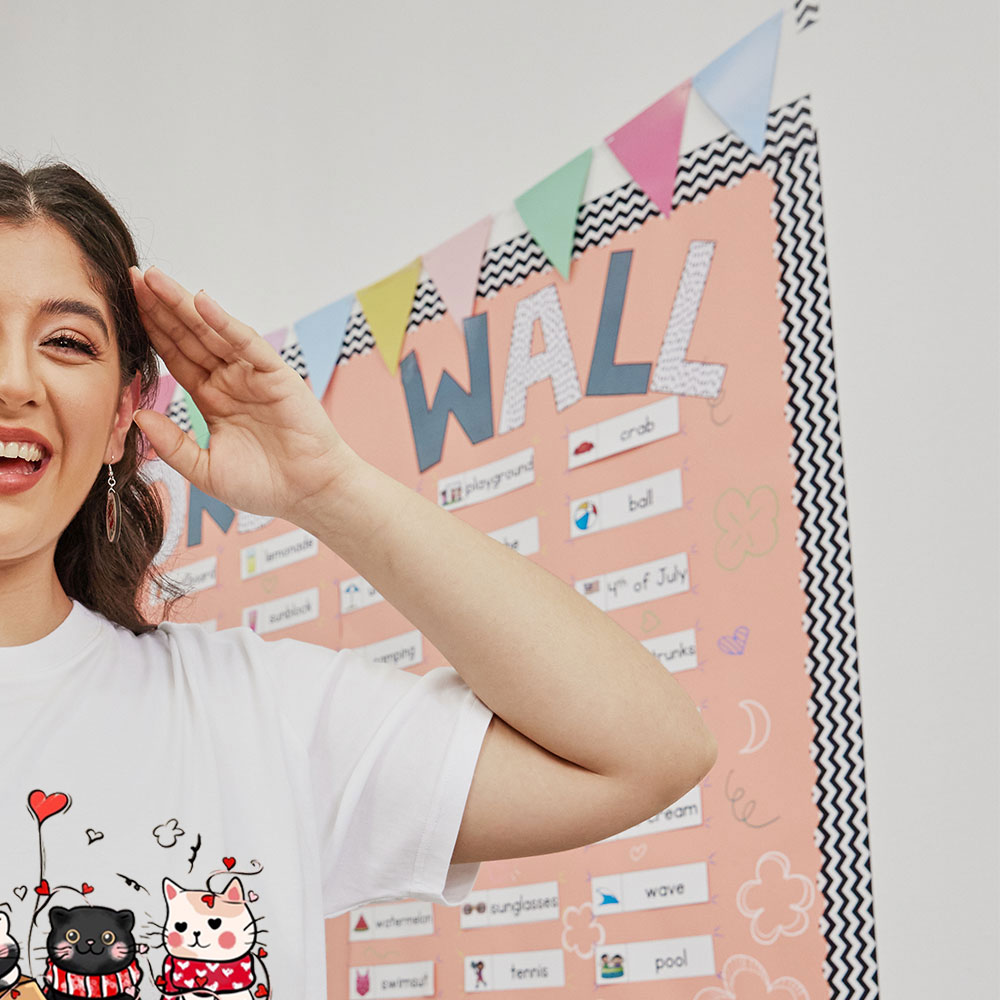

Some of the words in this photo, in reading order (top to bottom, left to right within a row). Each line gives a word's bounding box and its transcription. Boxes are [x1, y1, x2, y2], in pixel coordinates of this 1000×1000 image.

[400, 239, 727, 474] WALL
[619, 416, 655, 442] crab
[464, 453, 534, 495] playground
[628, 488, 654, 513] ball
[264, 536, 314, 563] lemonade
[633, 571, 650, 593] of
[656, 564, 689, 589] July
[644, 882, 686, 899] wave
[490, 893, 560, 918] sunglasses
[375, 912, 433, 929] watermelon
[510, 963, 550, 981] tennis
[653, 948, 688, 975] pool
